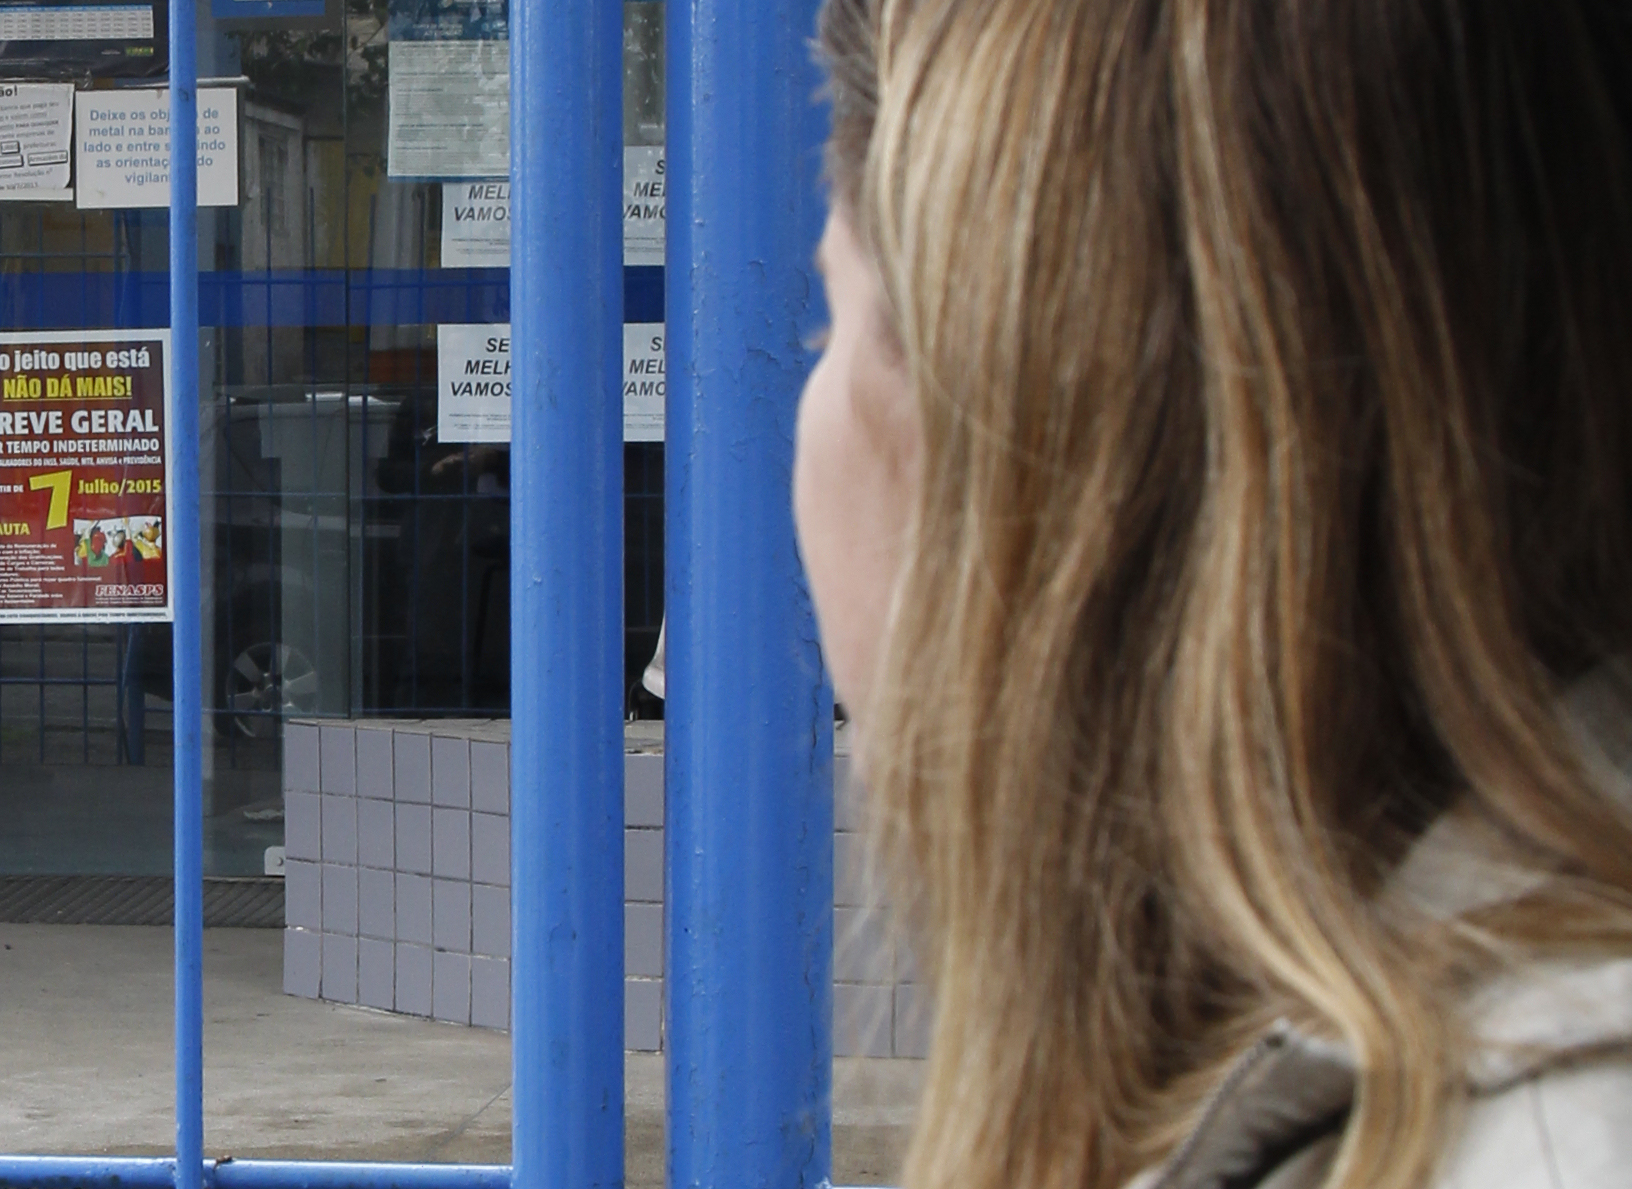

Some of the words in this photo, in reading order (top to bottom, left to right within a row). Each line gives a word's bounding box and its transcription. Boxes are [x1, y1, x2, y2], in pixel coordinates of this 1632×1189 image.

[90, 109, 126, 121] Deixe
[130, 112, 145, 120] os
[203, 108, 218, 119] de
[89, 125, 125, 136] metal
[129, 128, 144, 136] na
[204, 126, 220, 135] ao
[84, 141, 111, 152] lado
[116, 144, 123, 152] e
[127, 142, 160, 152] entre
[96, 158, 111, 168] as
[197, 155, 213, 166] do
[14, 350, 60, 373] jeito
[64, 351, 102, 372] que
[106, 346, 150, 368] está
[3, 374, 41, 399] NÃO
[46, 373, 73, 398] DÁ
[76, 375, 132, 397] MAIS!
[71, 409, 159, 434] GERAL
[6, 440, 50, 454] TEMPO
[53, 438, 159, 453] INDETERMINADO
[13, 485, 24, 493] DE
[78, 479, 161, 497] Julho/2015
[29, 470, 72, 530] 7
[95, 584, 163, 597] FENASPS
